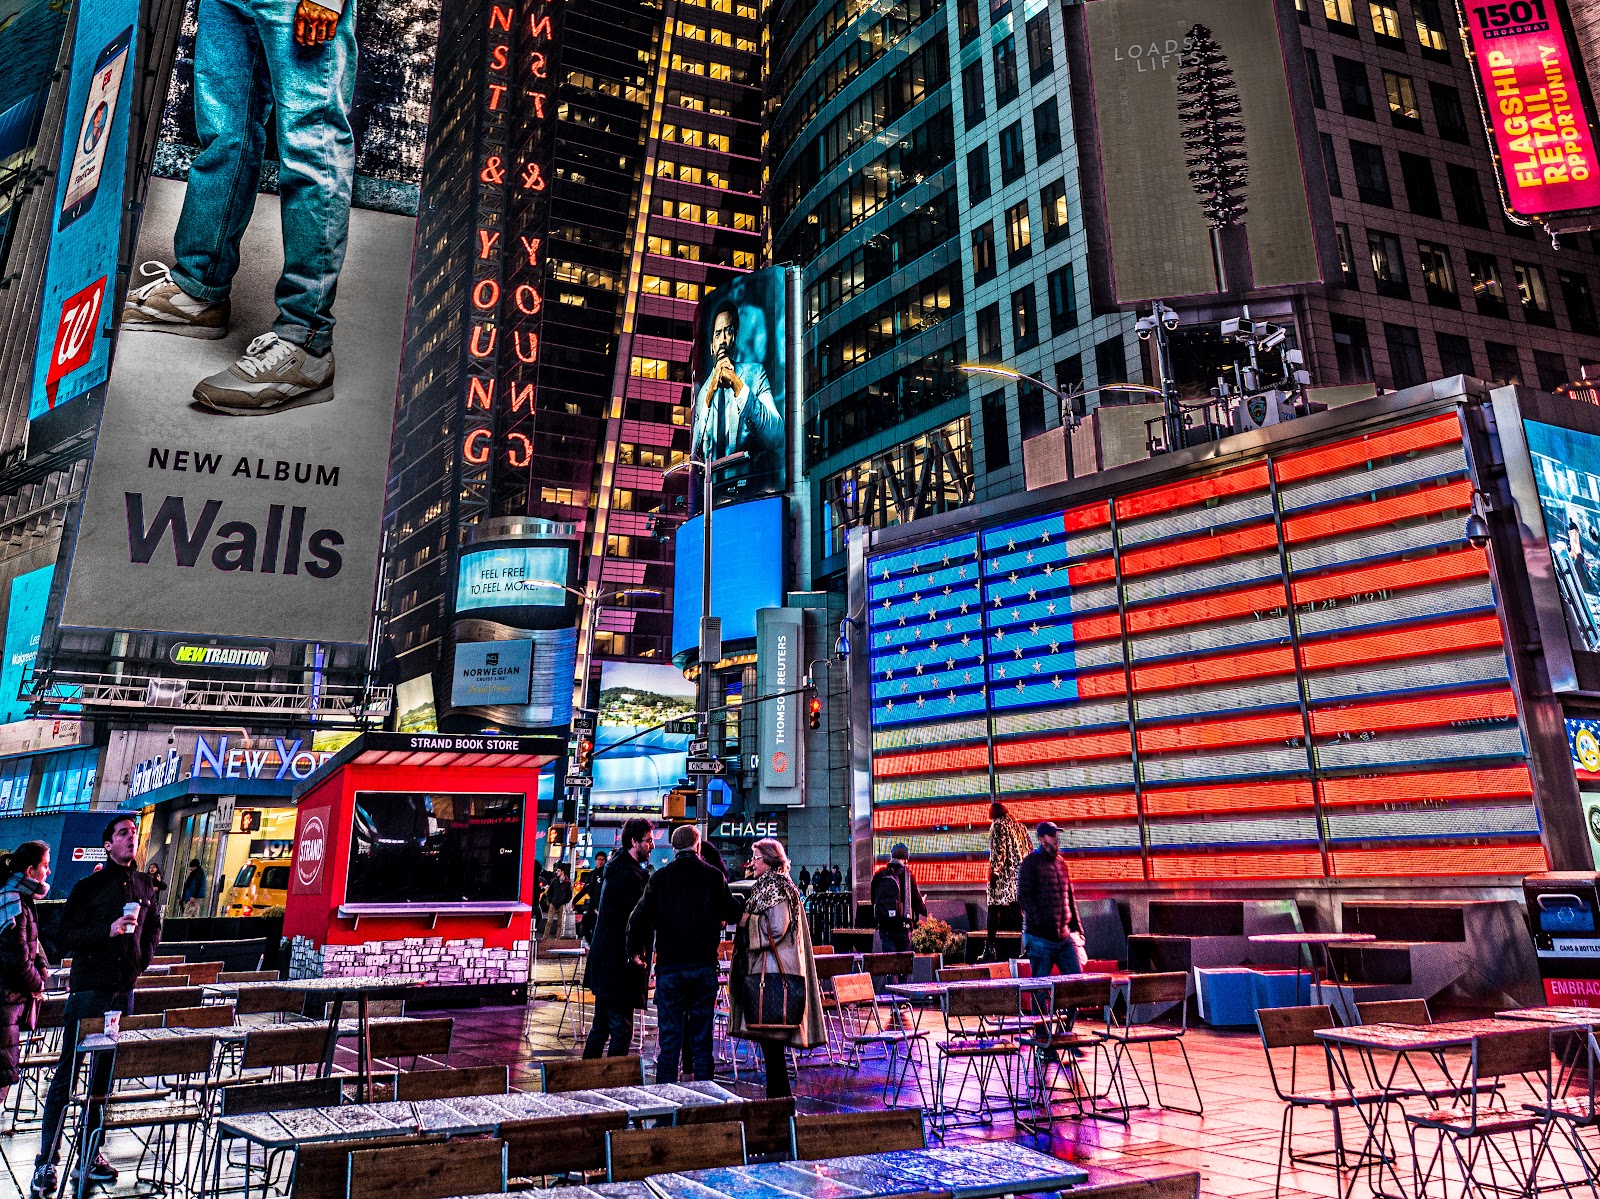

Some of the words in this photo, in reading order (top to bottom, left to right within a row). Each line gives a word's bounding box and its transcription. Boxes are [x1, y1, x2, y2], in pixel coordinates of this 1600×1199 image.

[1486, 23, 1547, 37] BROADWAY
[1114, 37, 1193, 61] LOADS
[1137, 51, 1200, 72] LIFTS
[1488, 50, 1542, 188] FLAGSHIP
[1538, 45, 1589, 181] OPPORTUNITY
[1524, 87, 1569, 185] RETAIL
[480, 156, 506, 184] &
[463, 230, 500, 464] YOUNG
[147, 448, 223, 474] NEW
[231, 457, 341, 486] ALBUM
[124, 491, 345, 579] Walls
[481, 569, 499, 579] FEEL
[502, 567, 525, 577] FREE
[471, 584, 480, 594] TO
[483, 582, 501, 593] FEEL
[777, 635, 787, 685] REUTERS
[463, 667, 520, 677] NORWEGIAN
[673, 723, 680, 732] W
[682, 723, 691, 732] 43
[776, 688, 787, 745] THOMSON
[411, 737, 453, 749] STRAND
[455, 738, 484, 750] BOOK
[486, 740, 519, 751] STORE
[192, 735, 269, 779] NEW
[273, 737, 335, 780] YOR
[691, 762, 704, 770] ONE
[708, 762, 721, 770] WAY
[720, 822, 778, 837] CHASE
[300, 839, 322, 862] STRAND
[1551, 981, 1600, 996] EMBRAC
